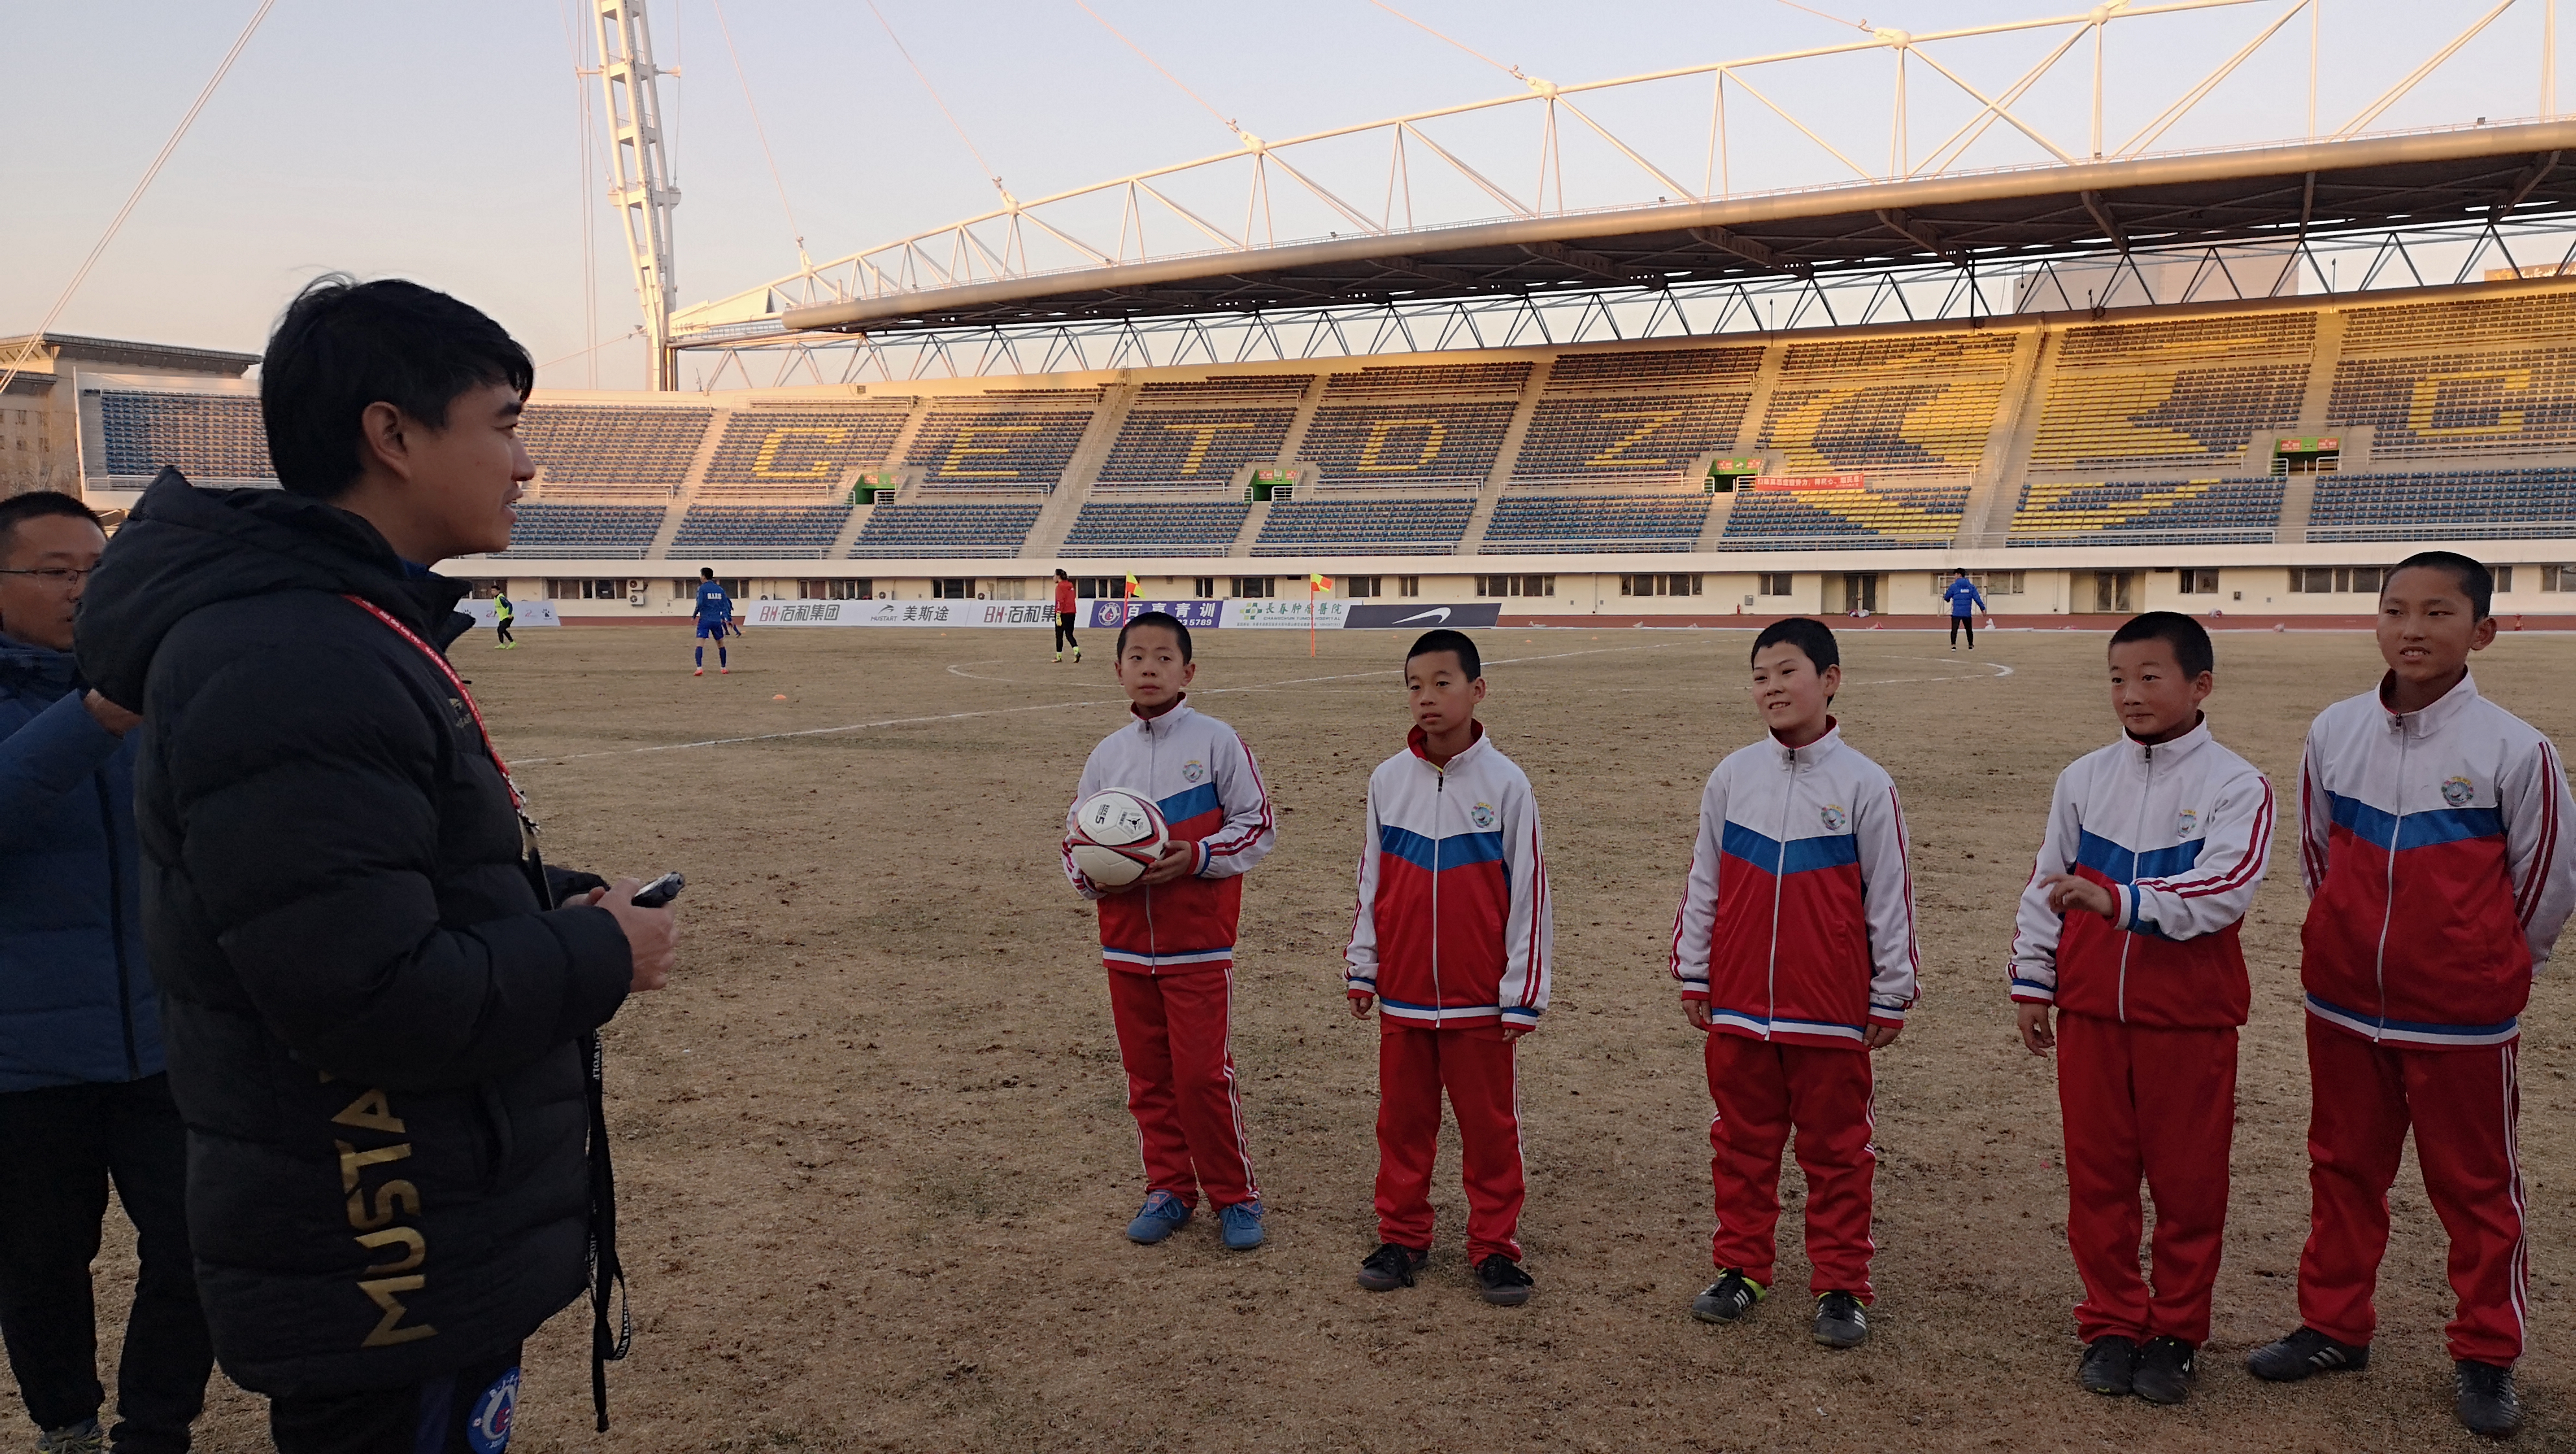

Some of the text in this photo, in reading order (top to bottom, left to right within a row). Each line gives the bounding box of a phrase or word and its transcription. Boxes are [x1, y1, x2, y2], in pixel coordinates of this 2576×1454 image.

[751, 426, 850, 478] C
[937, 425, 1043, 476] E
[1163, 423, 1255, 474] T
[1356, 418, 1446, 471] D
[1585, 411, 1682, 465] Z
[902, 605, 950, 622] 美斯途
[984, 604, 1056, 623] BH·百和集
[1095, 815, 1105, 824] 5
[330, 1087, 440, 1348] MUSTA
